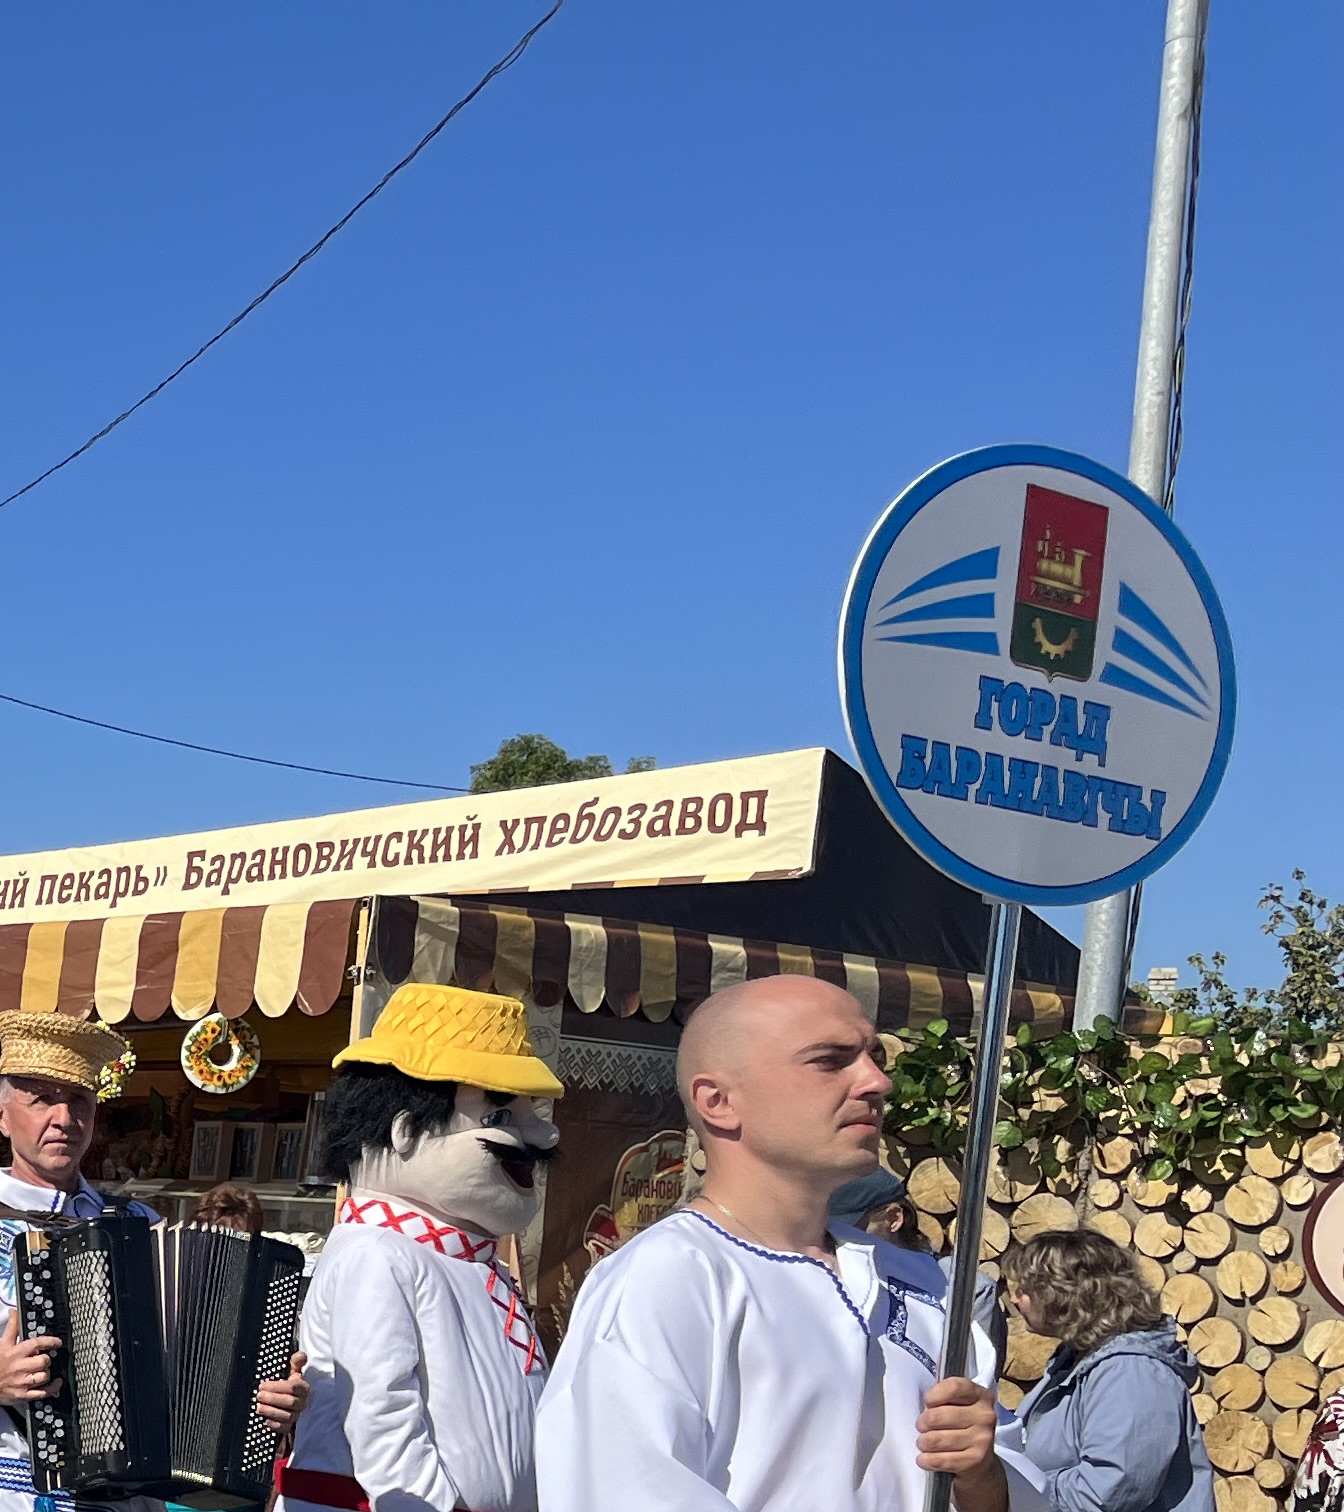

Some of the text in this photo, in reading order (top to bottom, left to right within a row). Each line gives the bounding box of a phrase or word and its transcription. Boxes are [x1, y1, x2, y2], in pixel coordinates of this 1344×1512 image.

[974, 675, 1111, 767] ГОРАД
[896, 735, 1167, 841] БАРАНАВІЧЫ
[36, 864, 168, 909] пекарь»
[181, 814, 481, 895] Барановичский
[494, 789, 769, 856] хлебозавод
